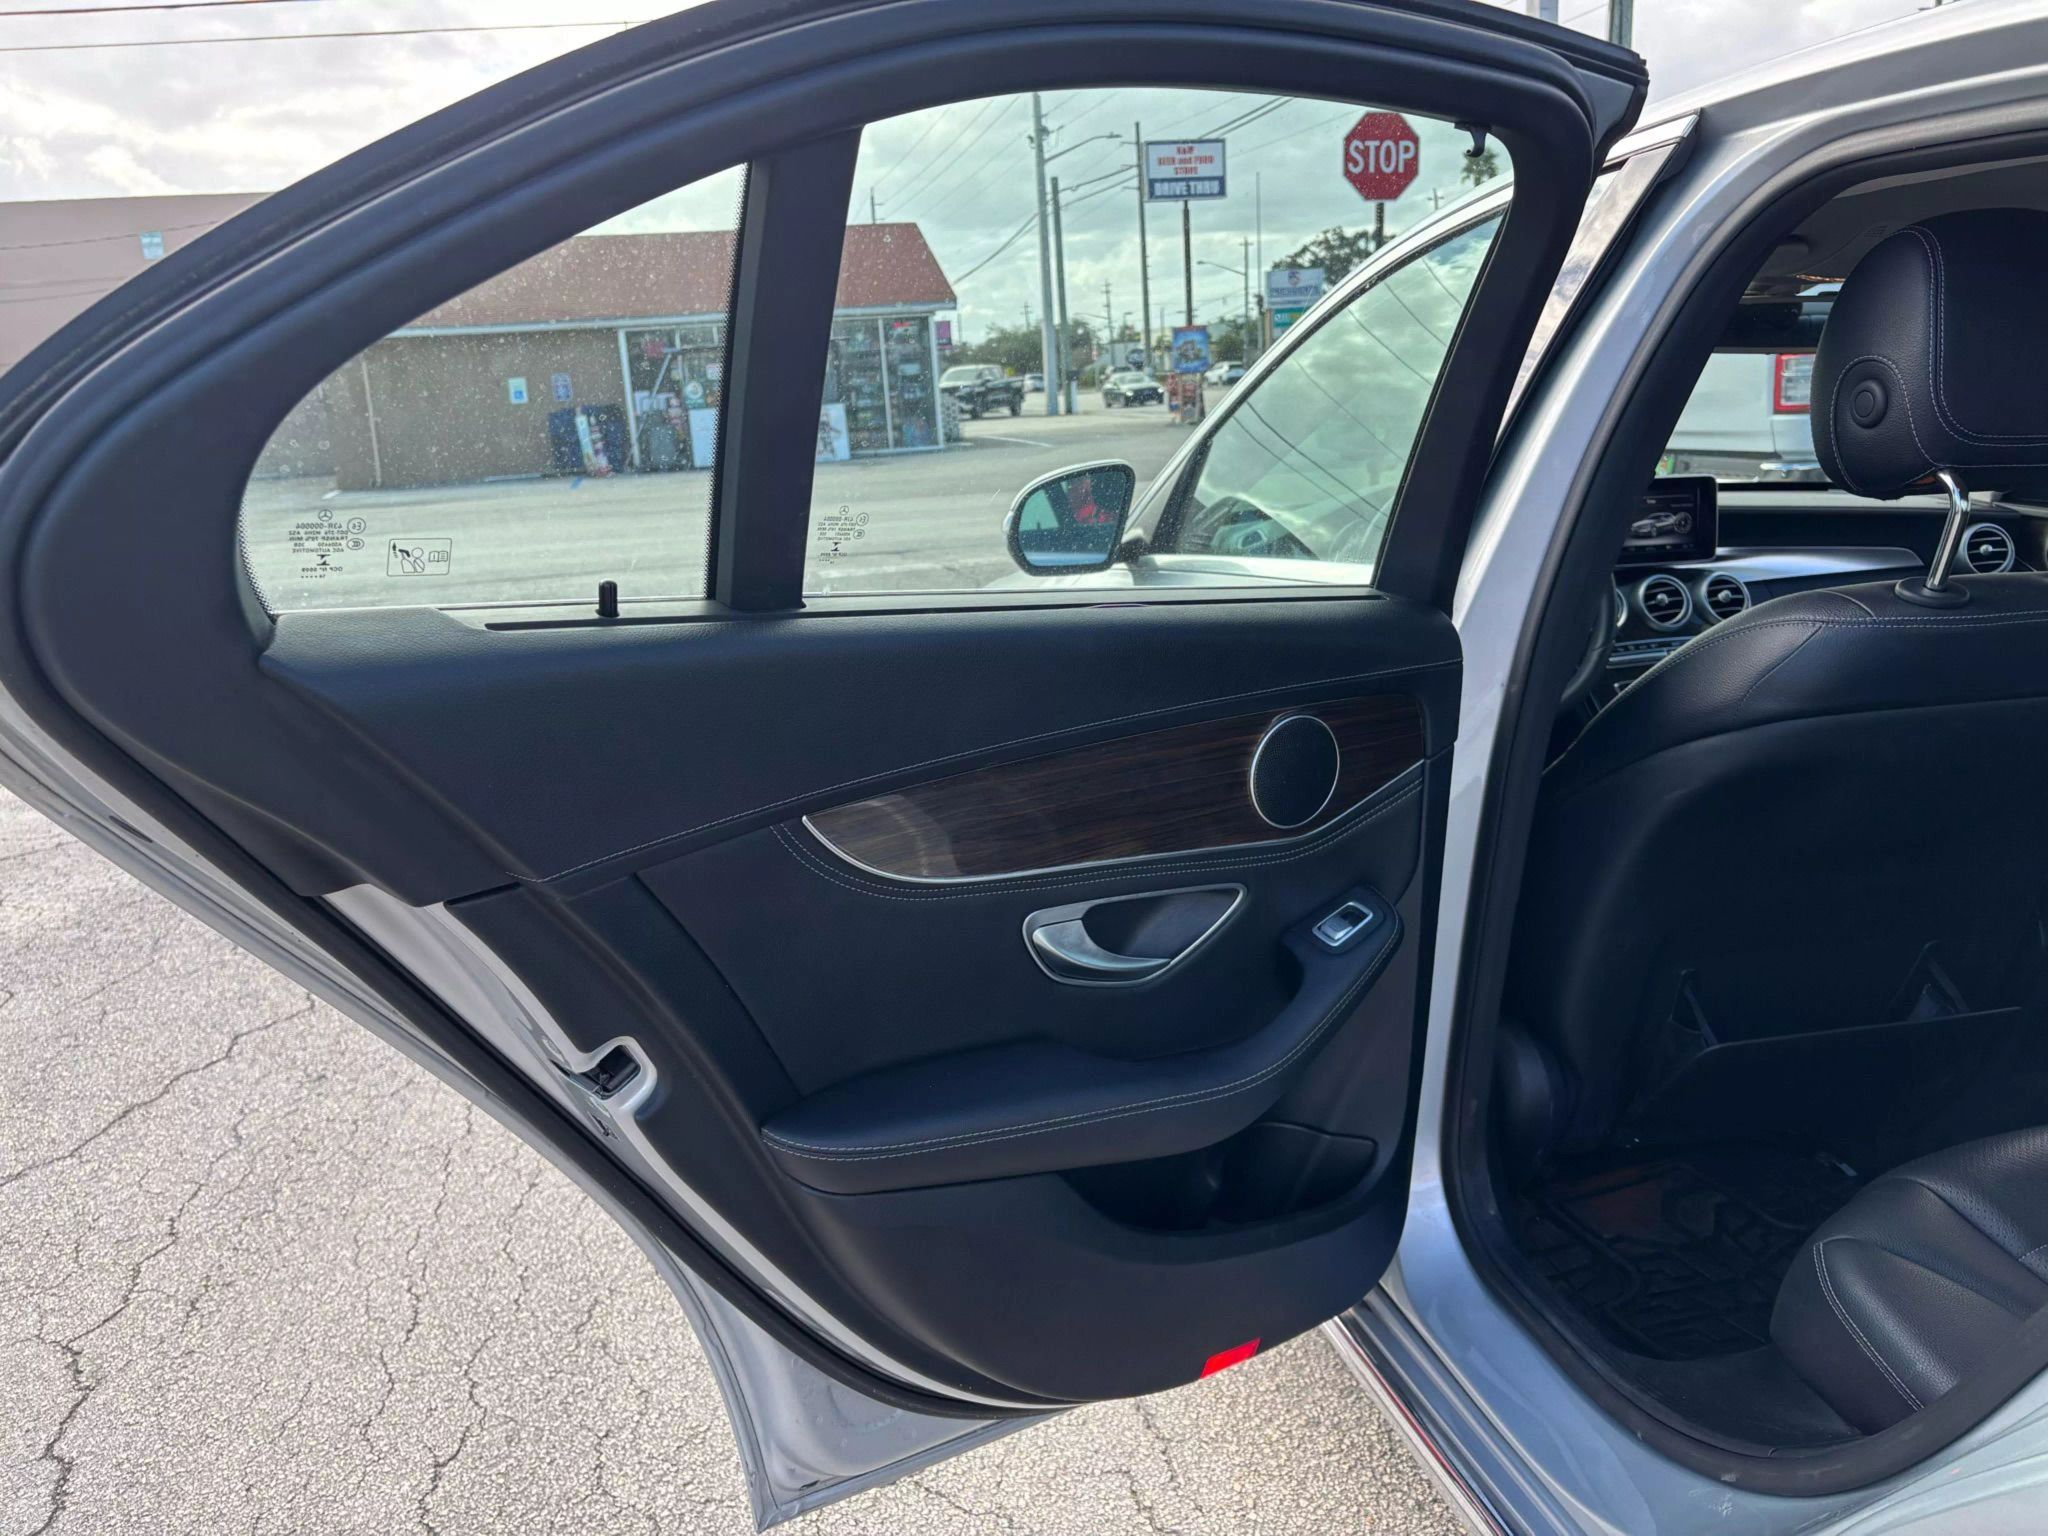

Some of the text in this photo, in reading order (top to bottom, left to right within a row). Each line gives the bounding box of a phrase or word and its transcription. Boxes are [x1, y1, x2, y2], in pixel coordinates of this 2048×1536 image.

[1347, 139, 1416, 174] STOP
[1154, 181, 1220, 196] DRIVE THRU
